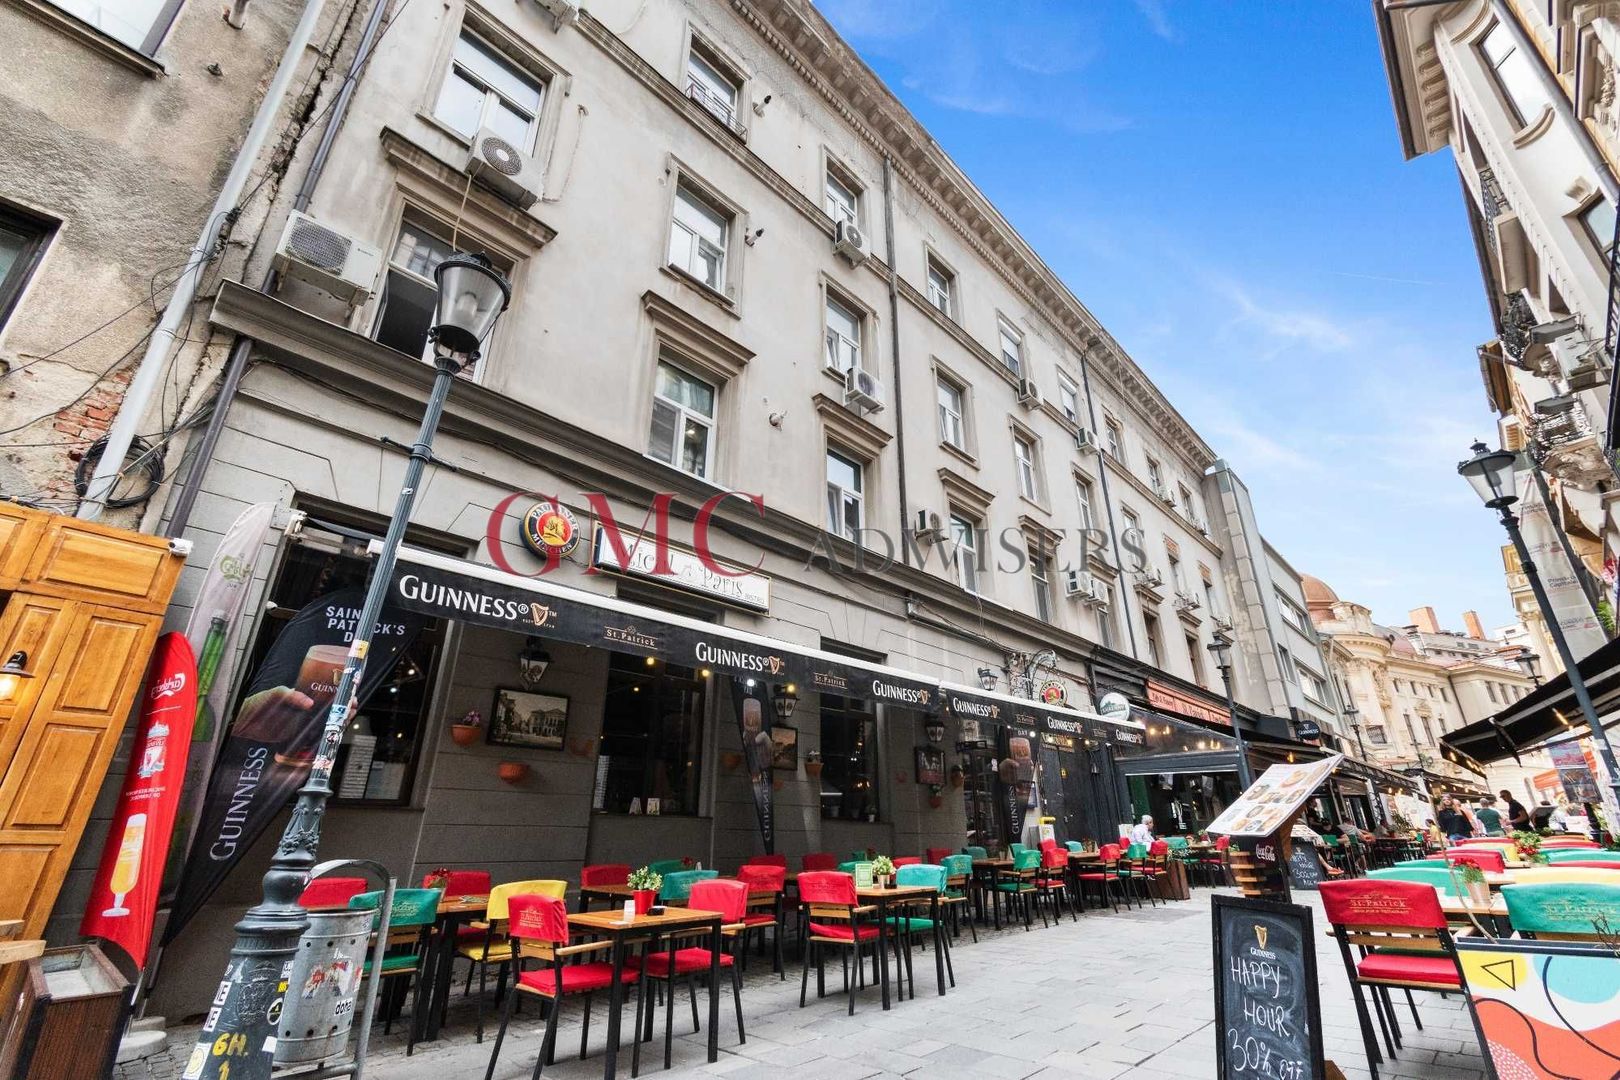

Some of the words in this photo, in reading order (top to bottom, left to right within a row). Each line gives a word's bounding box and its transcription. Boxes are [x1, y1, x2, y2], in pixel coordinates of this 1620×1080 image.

[399, 575, 518, 620] GUINNESS
[326, 606, 361, 620] SAIN
[327, 618, 406, 636] PATCK'S
[696, 642, 764, 672] GUINNESS
[872, 680, 918, 704] GUINNESS
[953, 697, 990, 718] GUINNESS
[210, 747, 268, 861] GUINNESS
[1250, 946, 1276, 960] GUINNESS
[1230, 956, 1280, 999] HAPPY
[1243, 996, 1290, 1038] HOUR
[1228, 1028, 1272, 1076] 30%
